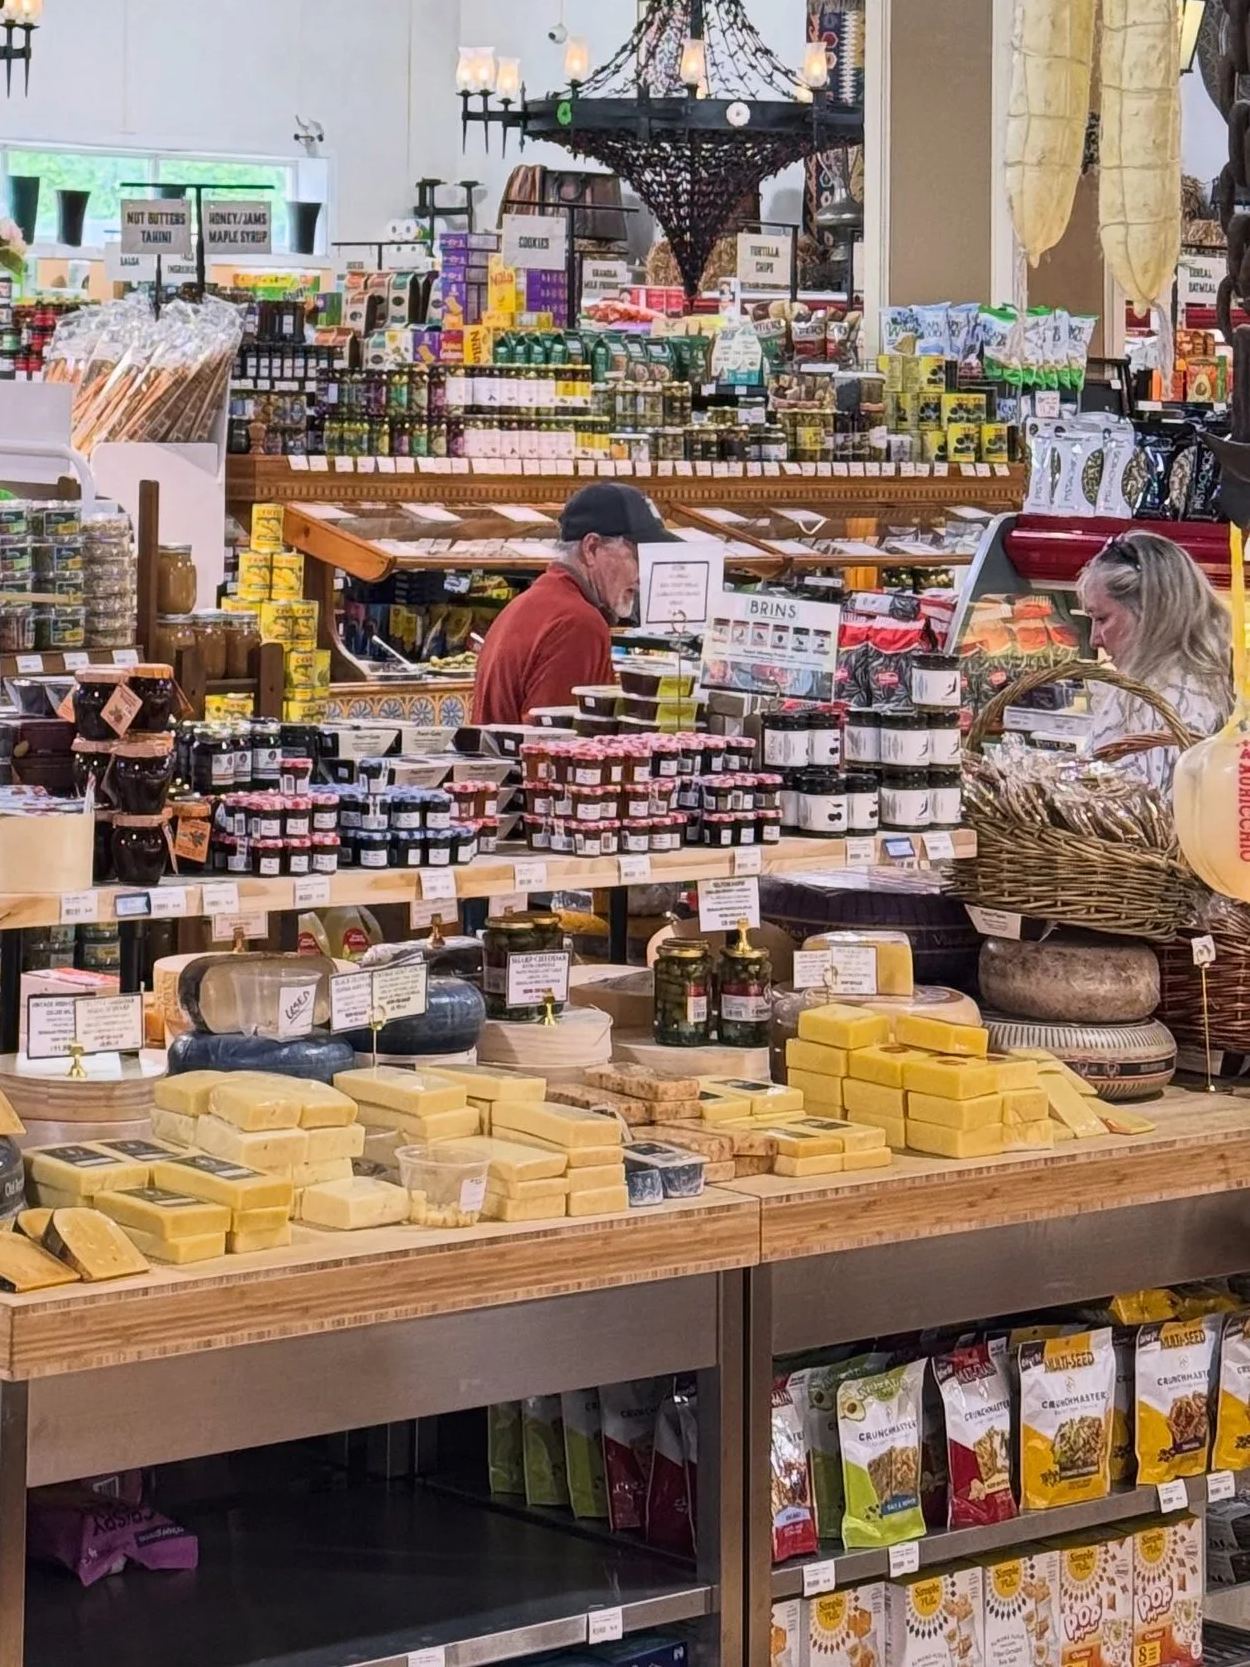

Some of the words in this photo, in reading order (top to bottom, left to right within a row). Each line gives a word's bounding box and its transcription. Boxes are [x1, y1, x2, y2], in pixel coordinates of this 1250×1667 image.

[127, 212, 144, 225] NUT
[148, 213, 186, 226] BUTTERS
[209, 212, 267, 226] HONEY/JAMS
[141, 230, 171, 244] TAHINI
[209, 230, 238, 243] MAPLE
[241, 231, 268, 244] SYRUP
[518, 236, 550, 249] COOKIES
[750, 600, 797, 619] BRINS
[1160, 1329, 1206, 1351] MULTI-SEED
[1044, 1351, 1095, 1374] MULTI-SEED
[1157, 1369, 1210, 1387] CRUNCHMAST
[1041, 1391, 1108, 1410] CRUNCHMASTER
